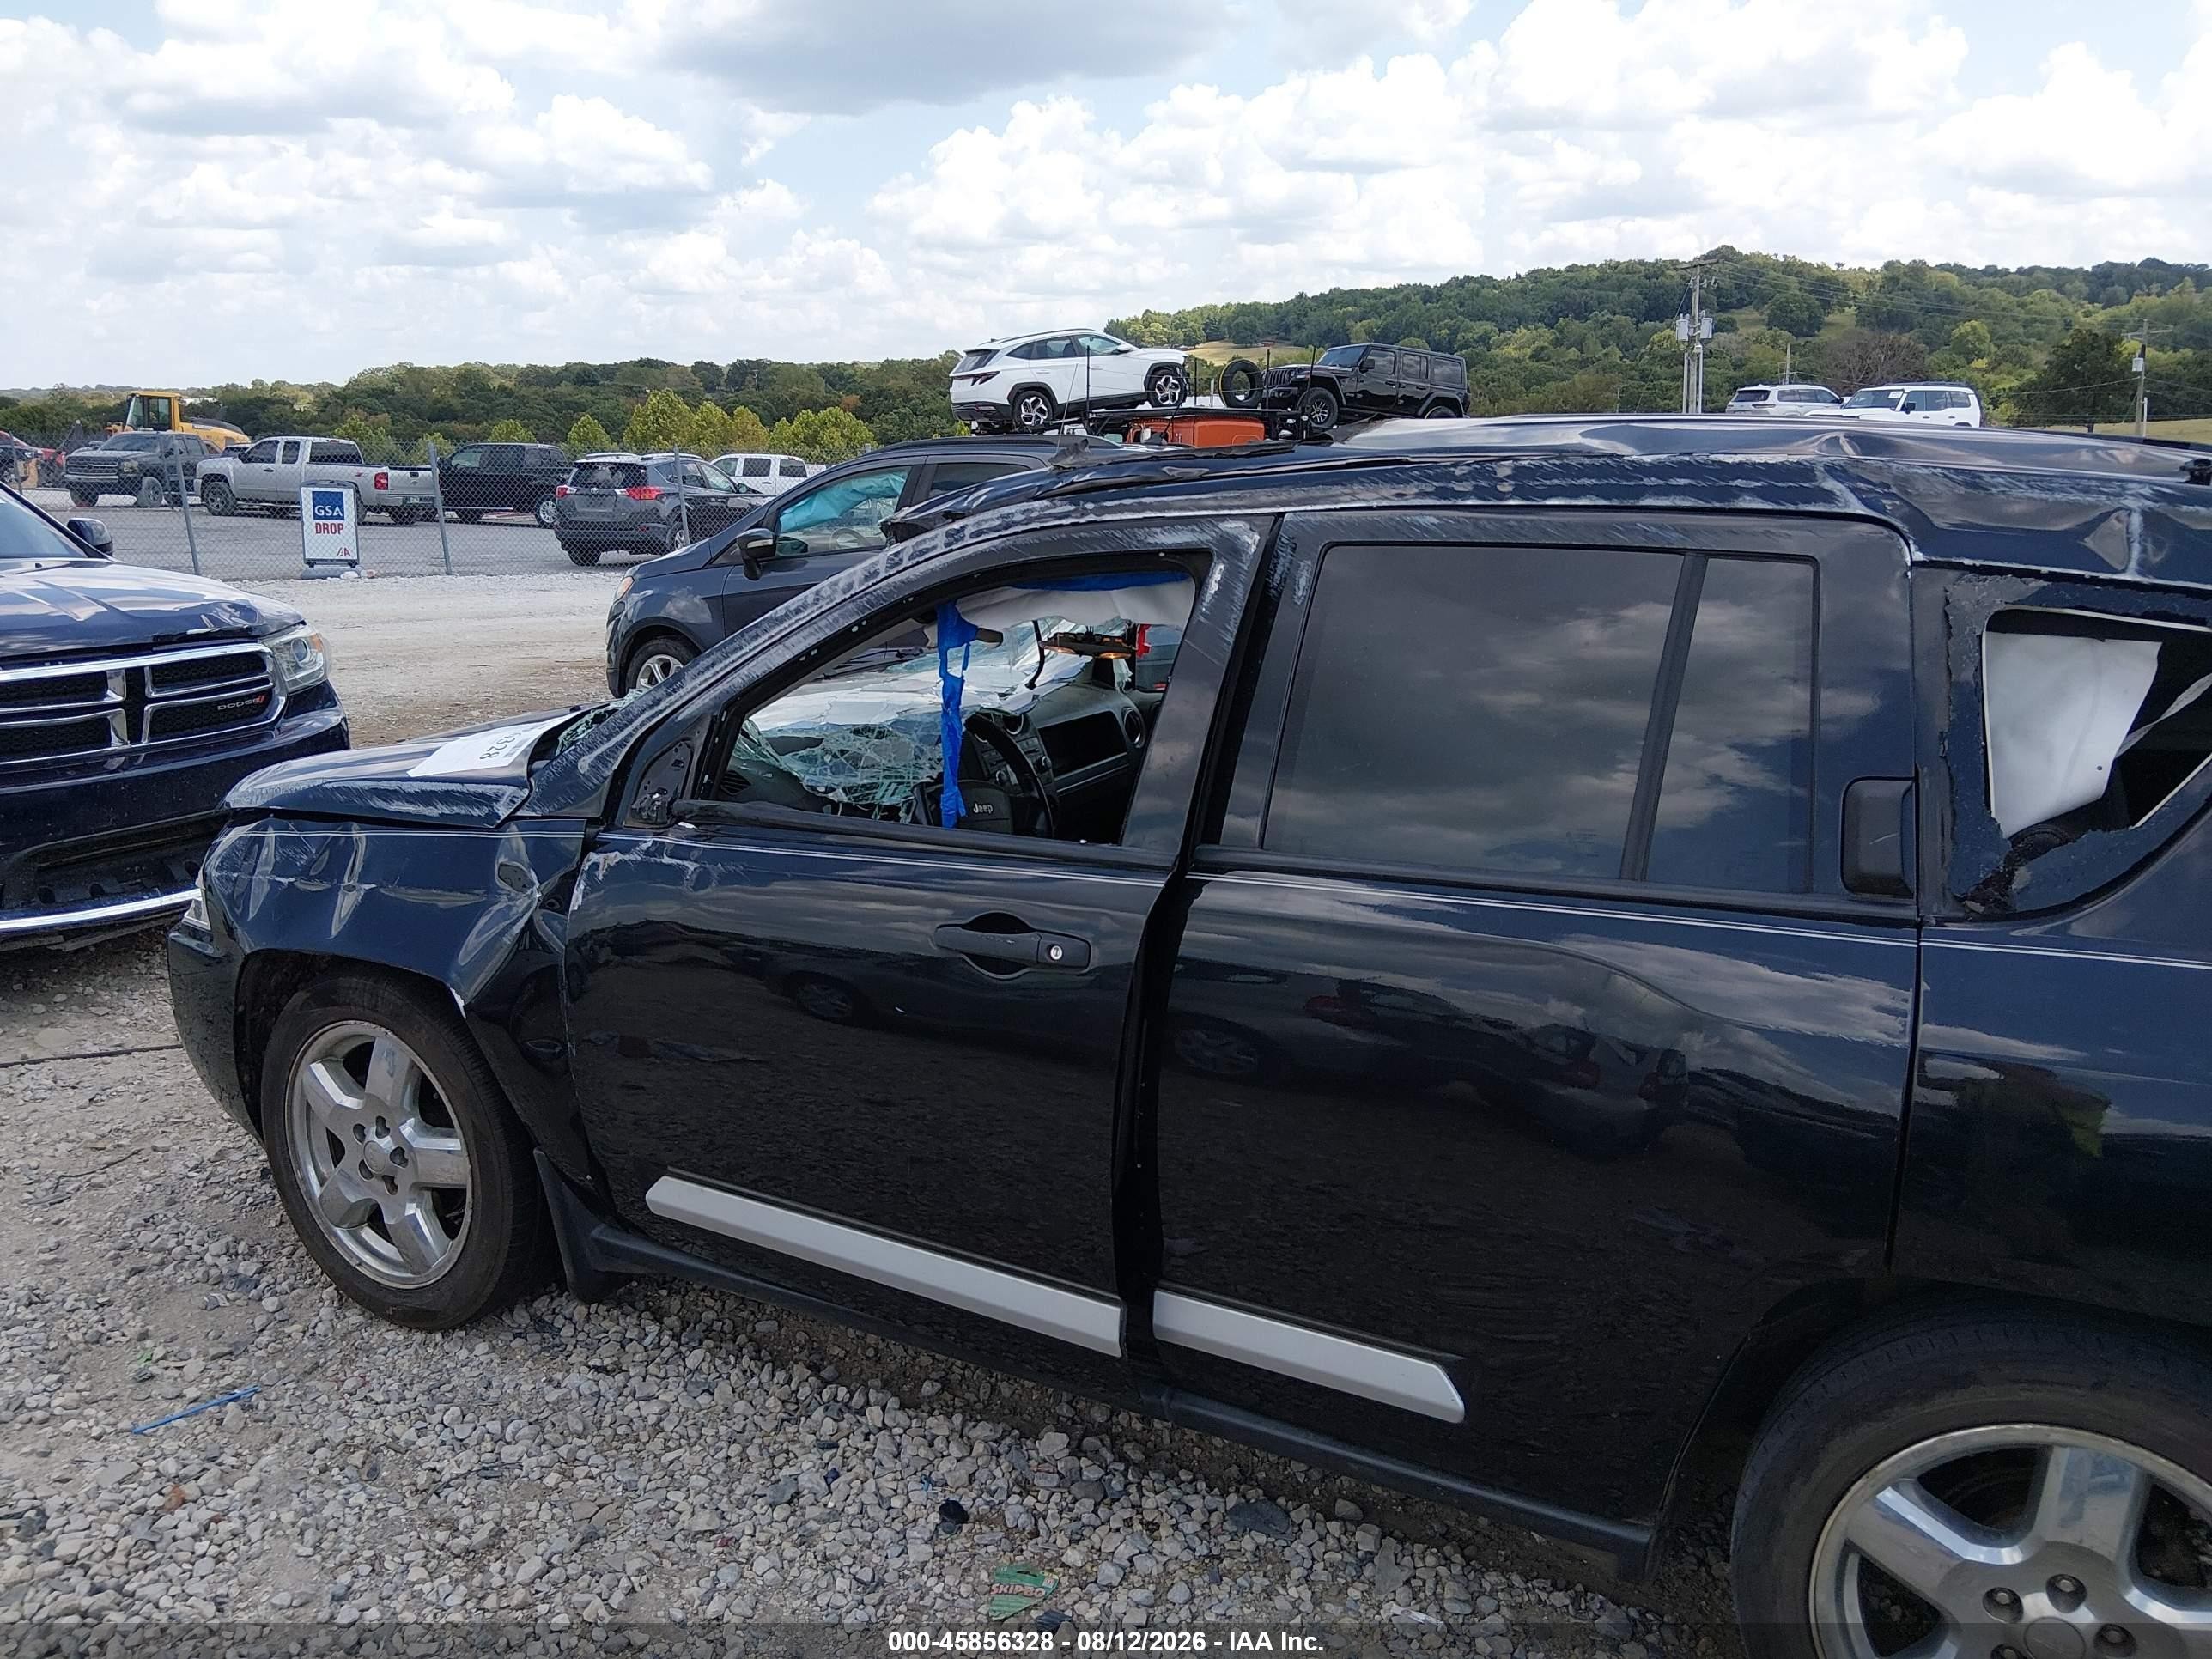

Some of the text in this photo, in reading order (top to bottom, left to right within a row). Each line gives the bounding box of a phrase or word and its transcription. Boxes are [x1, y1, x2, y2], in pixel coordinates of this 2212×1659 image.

[314, 505, 343, 517] GSA
[315, 522, 344, 535] DROP
[216, 697, 261, 710] DODGE
[973, 803, 994, 814] Jeep
